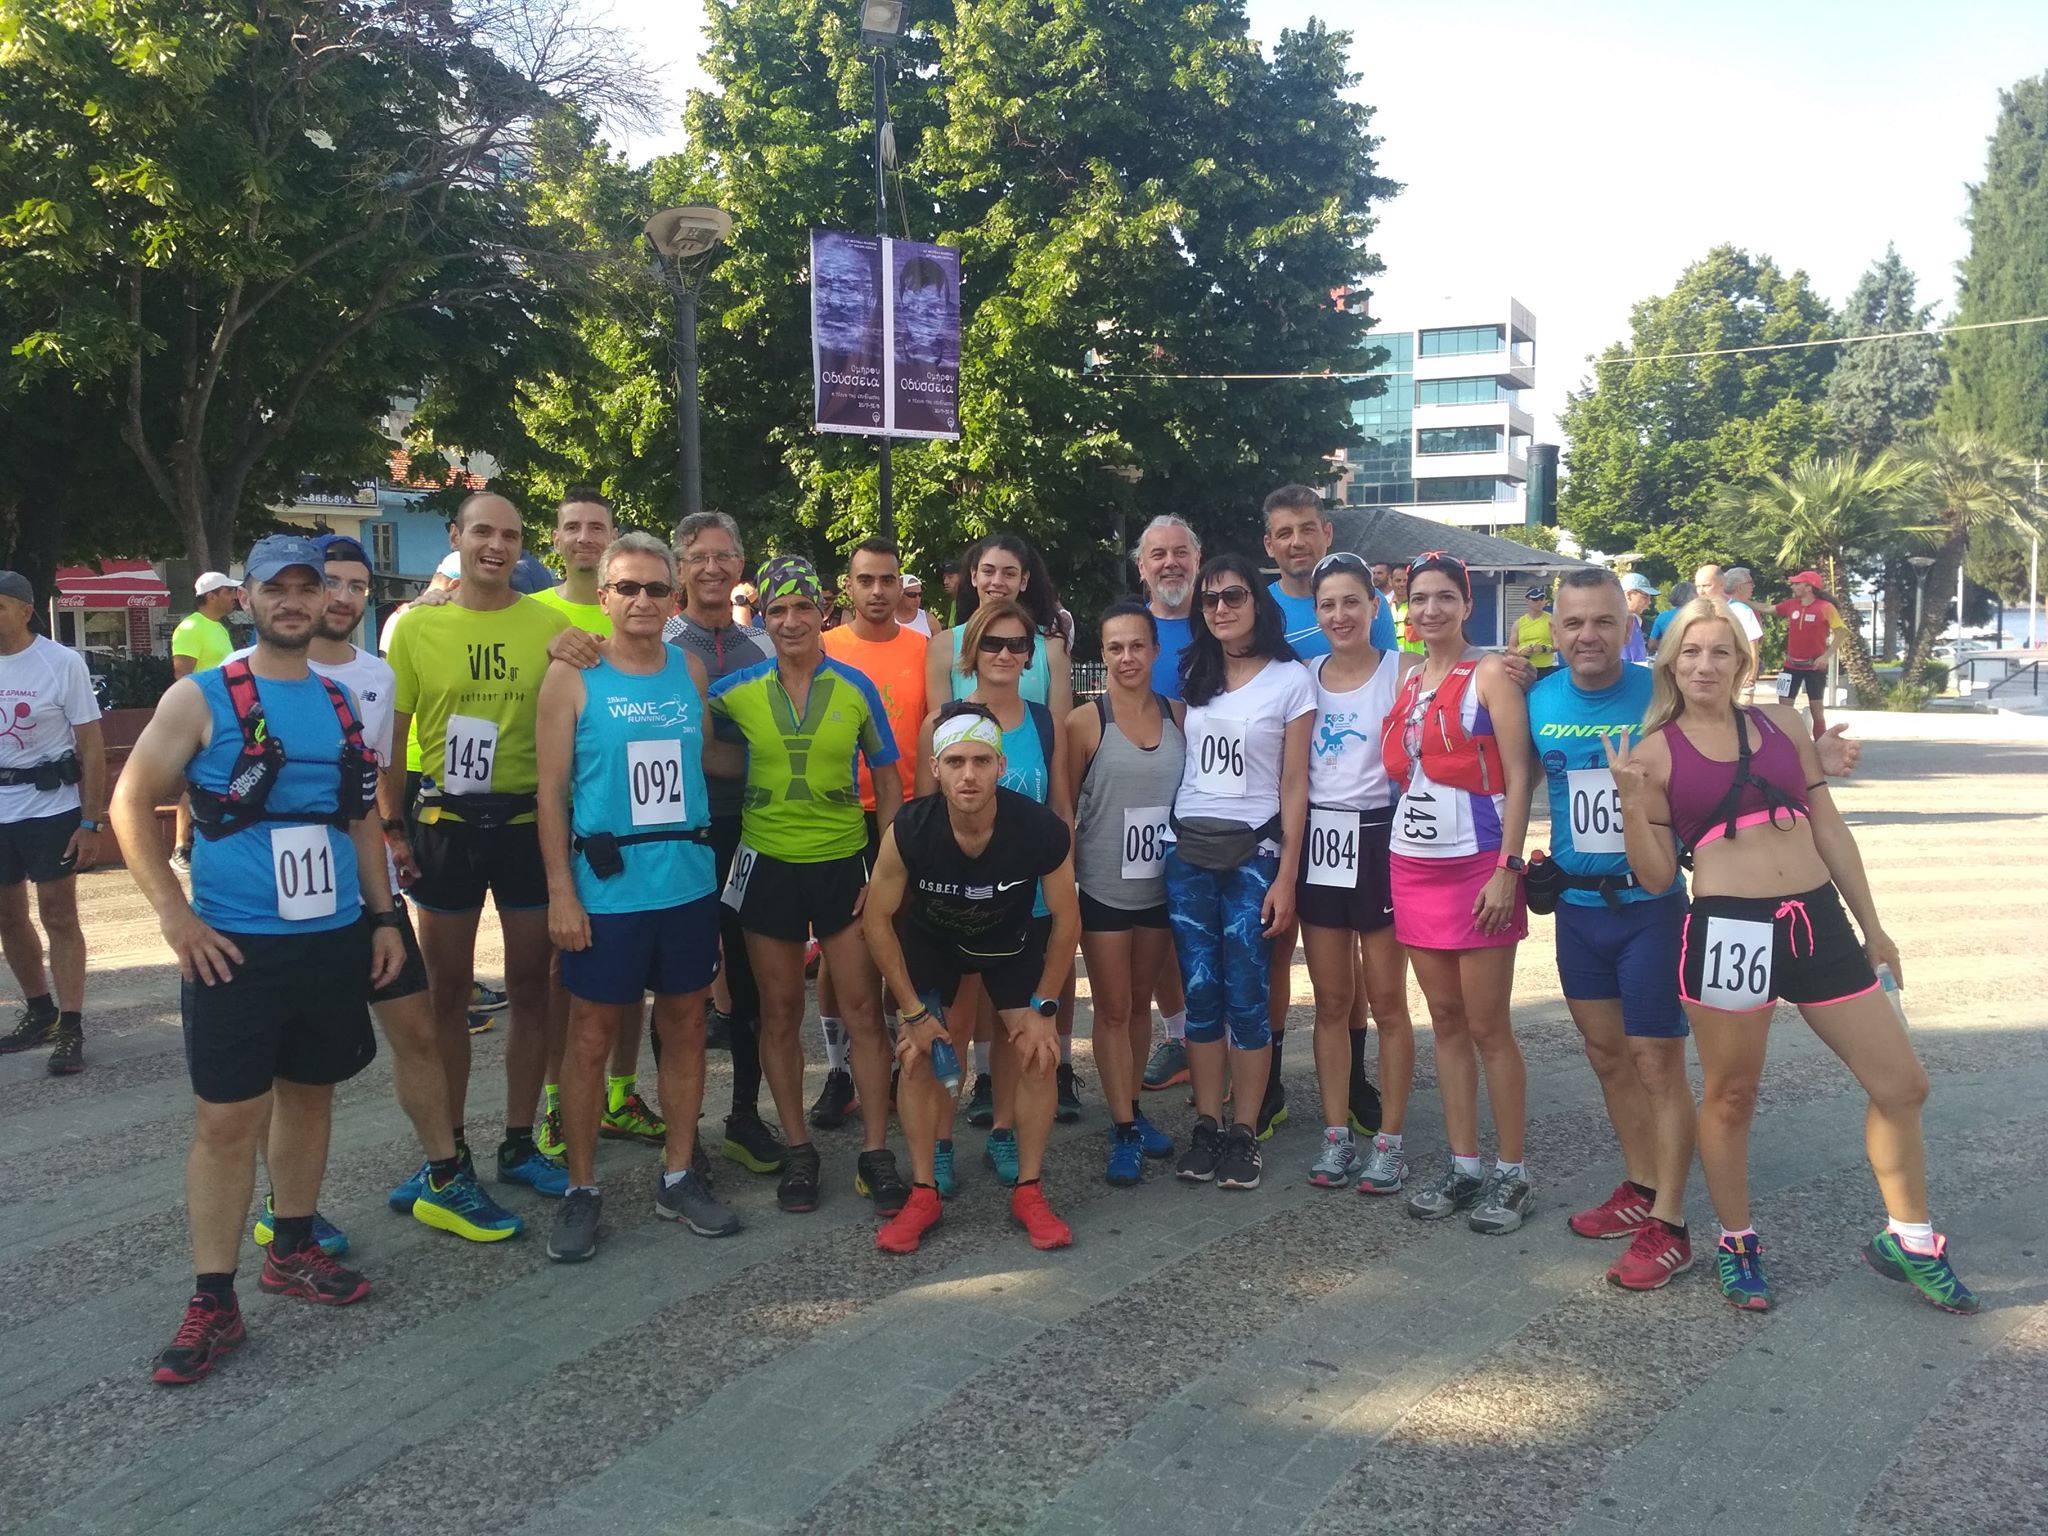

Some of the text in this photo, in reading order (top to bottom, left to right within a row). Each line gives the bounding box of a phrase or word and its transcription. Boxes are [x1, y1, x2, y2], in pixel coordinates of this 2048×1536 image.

[822, 371, 880, 388] Οδύσσεια
[900, 378, 954, 394] Οδύσσεια
[6, 690, 37, 698] ΔΡΑΜΑΣ
[608, 702, 659, 718] WAVE
[628, 714, 667, 723] RUNNING
[447, 734, 494, 782] 145
[1201, 734, 1244, 777] 096
[633, 760, 681, 806] 092
[1404, 792, 1438, 840] 143
[1574, 789, 1624, 834] 065
[1126, 823, 1167, 863] 083
[1312, 827, 1356, 870] 084
[280, 846, 334, 899] 011
[1706, 940, 1767, 994] 136
